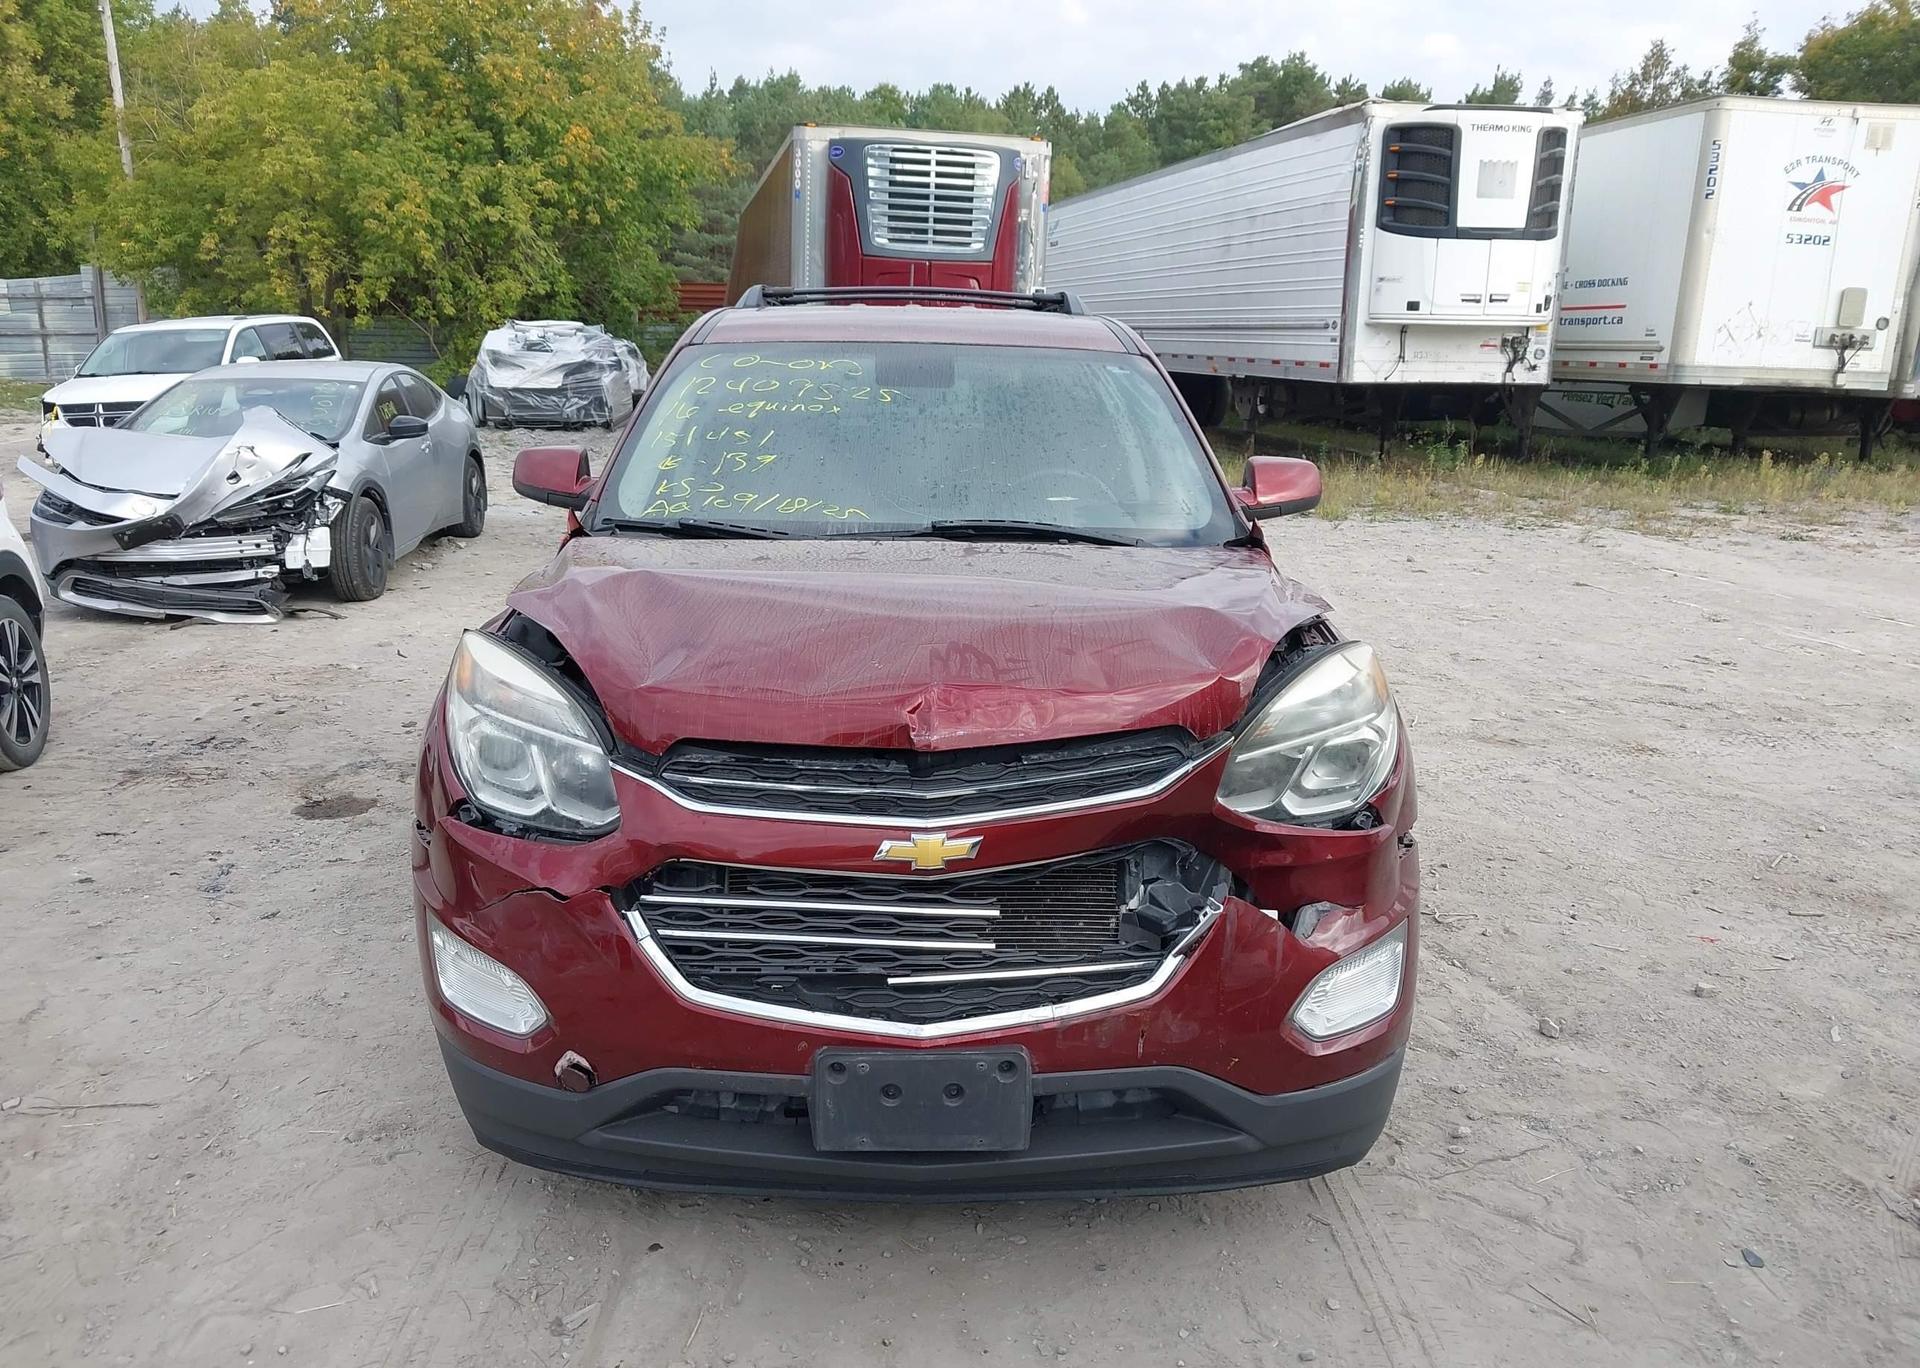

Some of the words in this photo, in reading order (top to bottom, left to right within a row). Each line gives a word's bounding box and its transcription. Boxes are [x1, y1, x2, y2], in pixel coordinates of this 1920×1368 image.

[1470, 123, 1510, 132] THERMO
[1511, 124, 1532, 133] KING
[1704, 139, 1721, 200] 53202
[1804, 155, 1861, 179] TRANSPORT
[1785, 233, 1831, 246] 53202
[1574, 278, 1596, 289] CROSS
[1597, 276, 1629, 288] DOCKING
